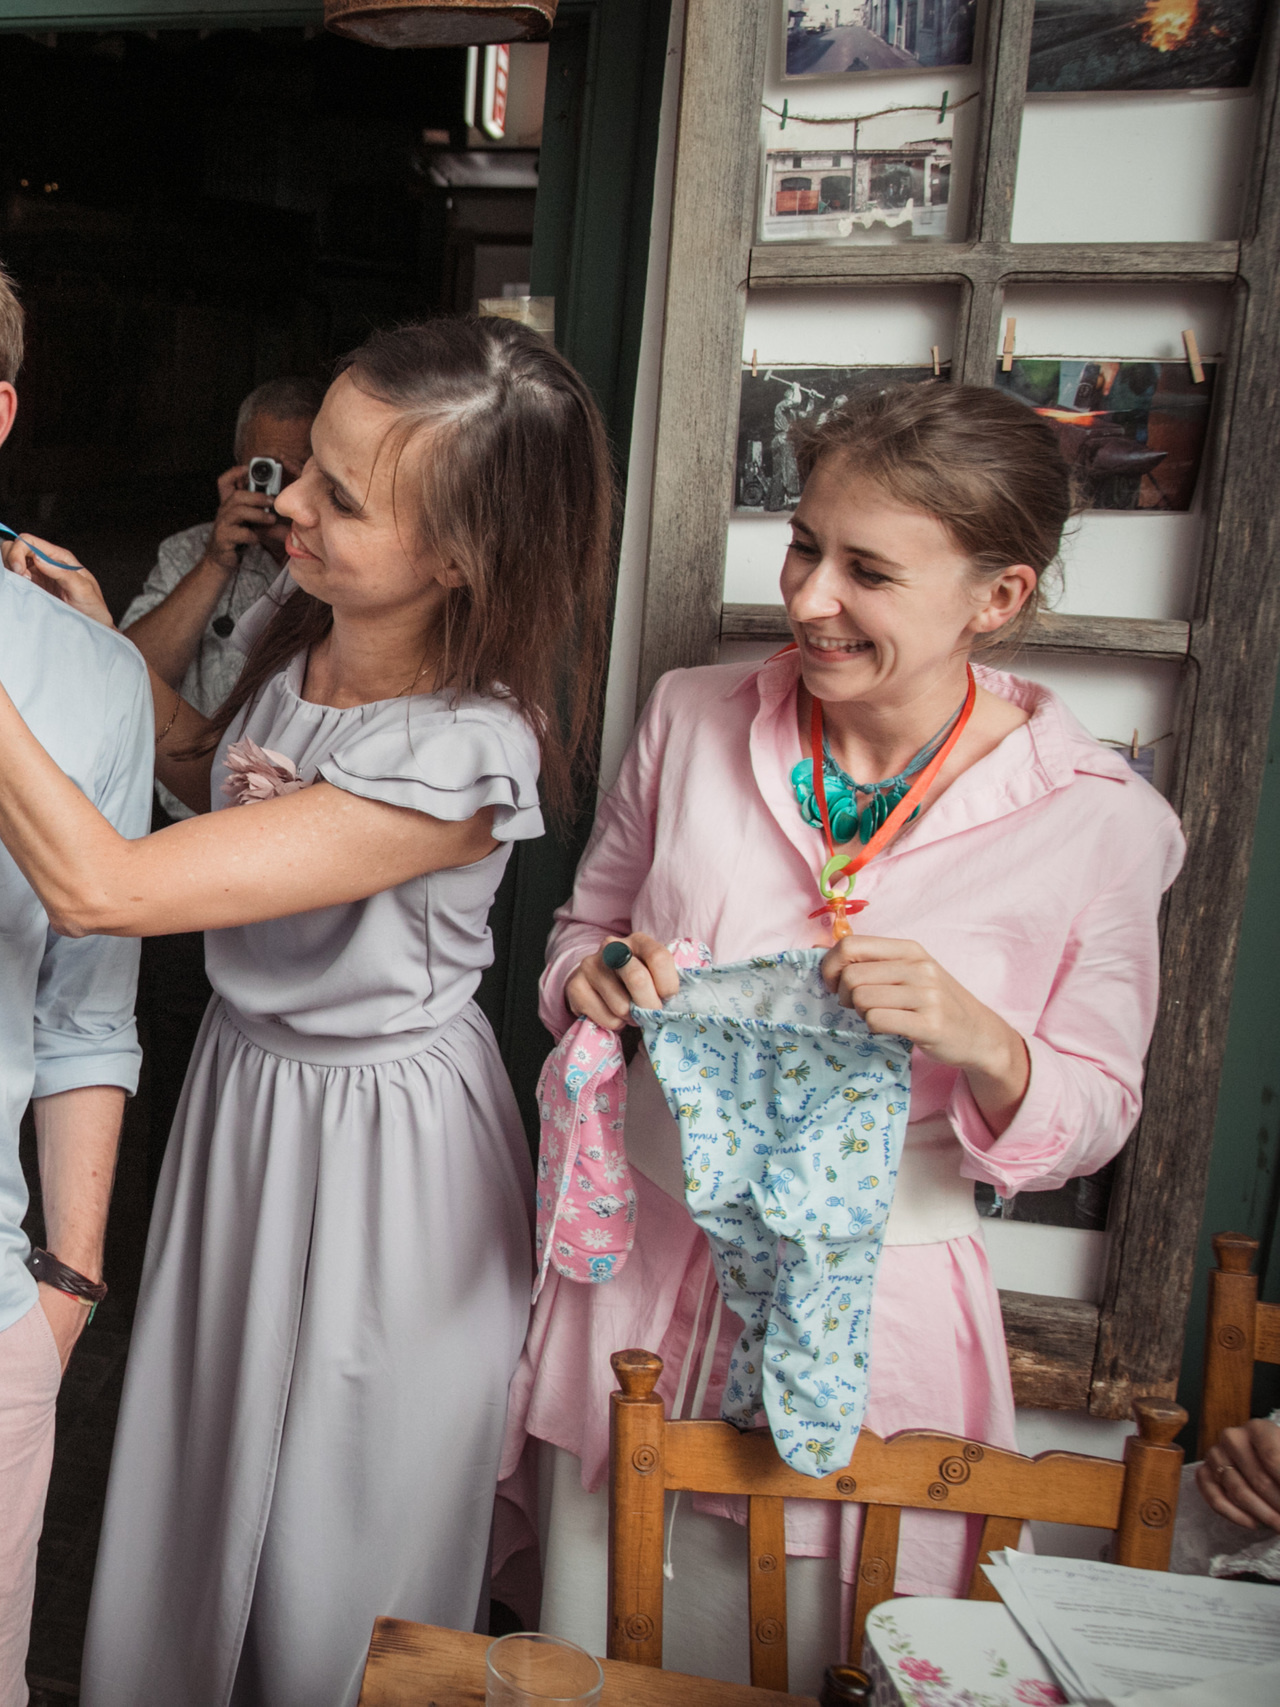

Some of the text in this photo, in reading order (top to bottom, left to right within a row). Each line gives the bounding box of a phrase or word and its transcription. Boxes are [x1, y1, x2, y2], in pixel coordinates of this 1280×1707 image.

[828, 1275, 863, 1285] friends
[847, 1309, 864, 1345] friends
[798, 1420, 841, 1431] friends
